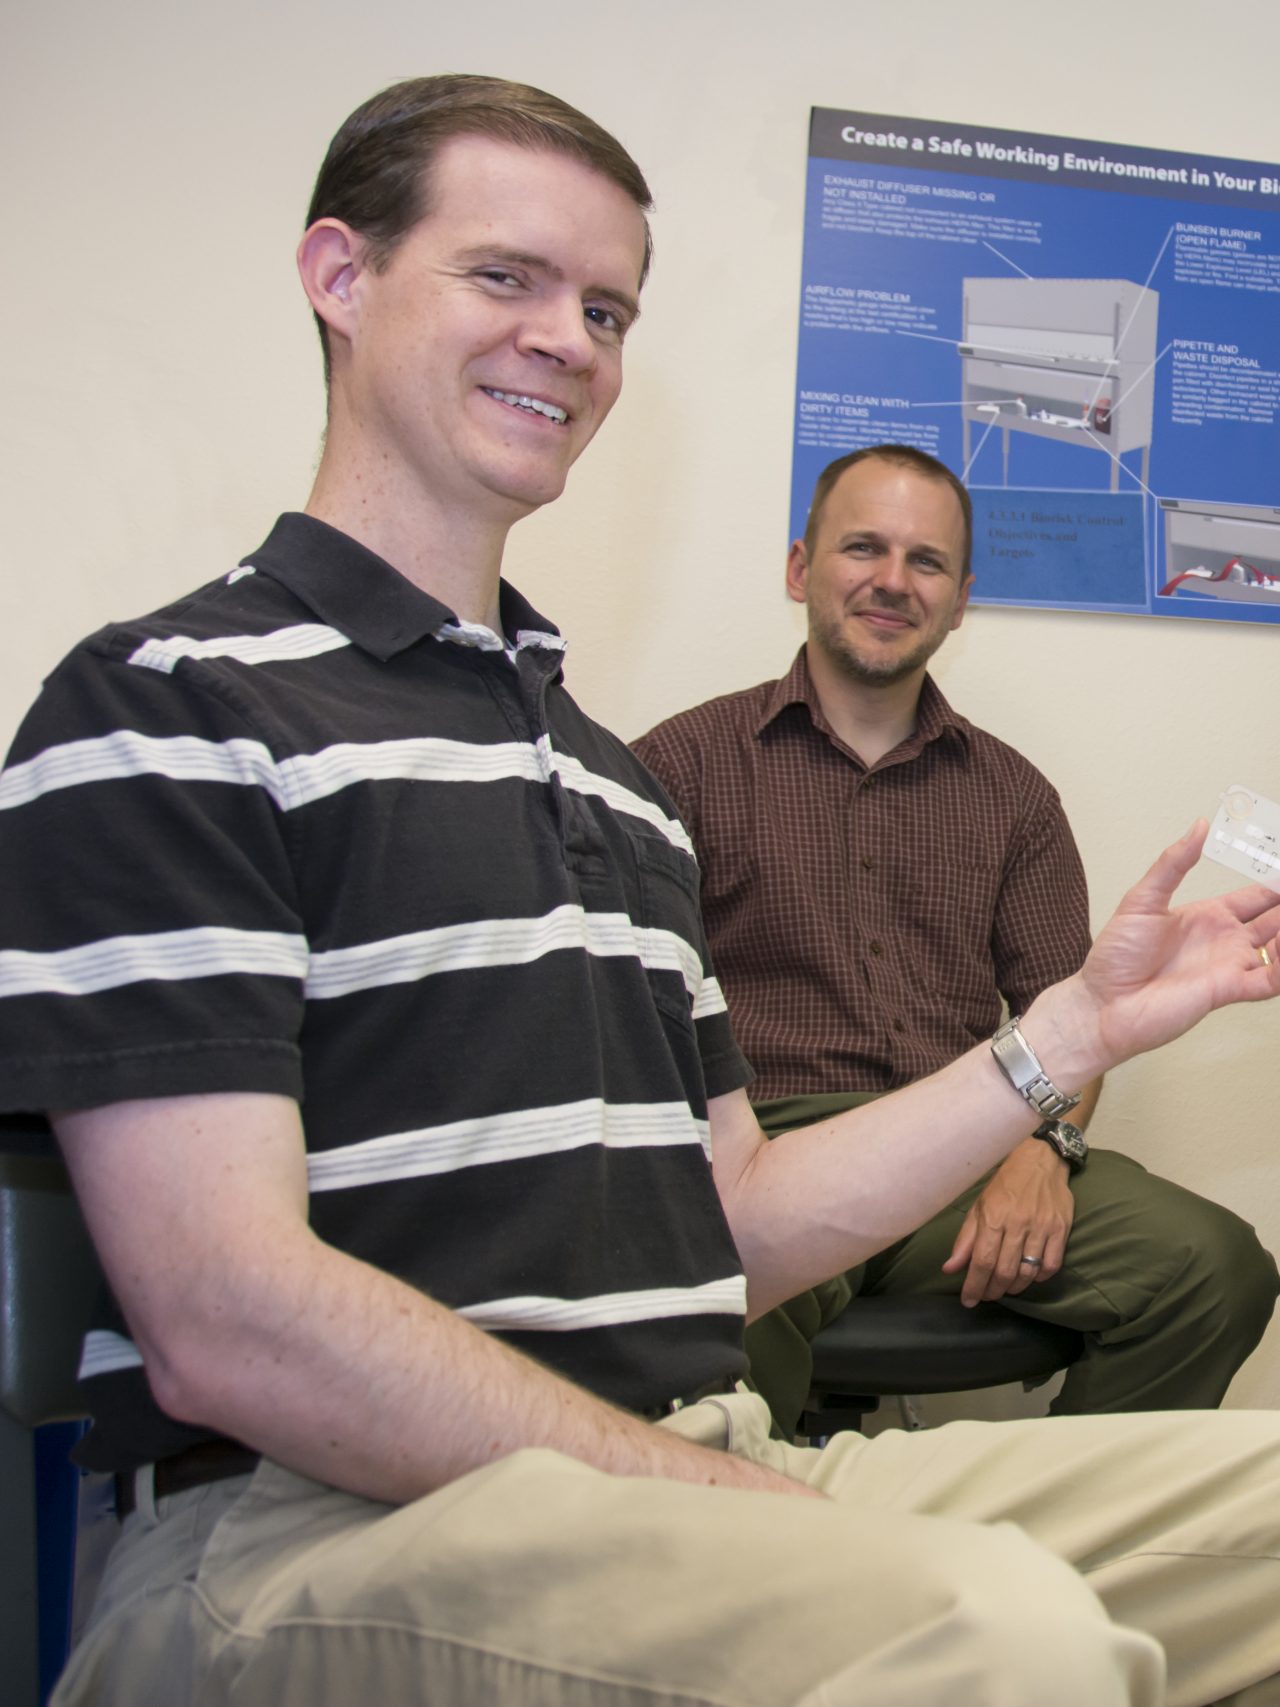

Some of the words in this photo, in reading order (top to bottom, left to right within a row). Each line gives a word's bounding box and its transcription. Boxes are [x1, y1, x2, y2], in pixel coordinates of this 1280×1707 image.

[842, 127, 908, 151] Create
[912, 138, 923, 151] a
[928, 136, 972, 158] Safe
[976, 142, 1059, 172] Working
[1063, 152, 1188, 184] Environment
[1192, 171, 1210, 187] in
[1213, 172, 1256, 192] Your
[824, 175, 875, 189] EXHAUST
[877, 180, 930, 195] DIFFUSER
[932, 187, 977, 202] MISSING
[978, 192, 995, 202] OR
[824, 187, 846, 197] NOT
[849, 190, 907, 205] INSTALLED
[1176, 222, 1218, 236] BUNSEN
[1219, 228, 1262, 241] BURNER
[1176, 234, 1208, 246] (OPEN
[1210, 238, 1246, 252] FLAME)
[805, 285, 855, 298] AIRFLOW
[857, 289, 911, 303] PROBLEM
[1173, 339, 1215, 352] PIPETTE
[1217, 343, 1239, 354] AND
[1173, 352, 1208, 363] WASTE
[1211, 355, 1260, 368] DISPOSAL
[800, 390, 840, 403] MIXING
[842, 394, 880, 407] CLEAN
[881, 398, 910, 409] WITH
[800, 403, 833, 415] DIRTY
[835, 405, 869, 418] ITEMS
[1077, 514, 1125, 526] Control
[989, 528, 1052, 542] Objectives
[1055, 531, 1078, 542] and
[990, 545, 1035, 559] Targets
